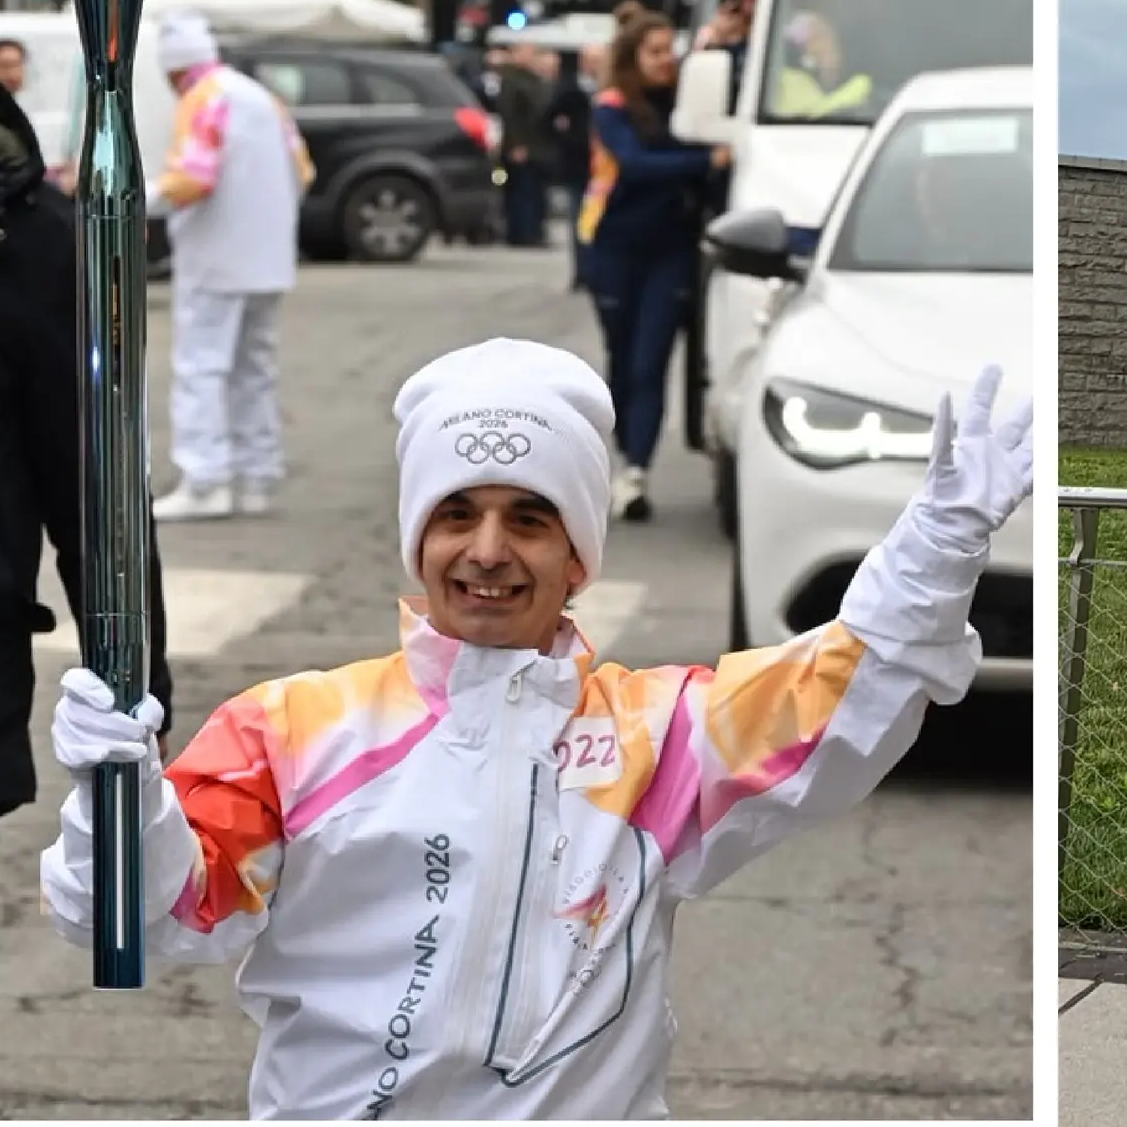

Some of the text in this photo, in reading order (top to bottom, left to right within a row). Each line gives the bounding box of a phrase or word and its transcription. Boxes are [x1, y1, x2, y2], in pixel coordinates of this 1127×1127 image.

[477, 418, 509, 429] 2026
[384, 914, 440, 1061] CORTINA
[424, 833, 451, 905] 2026
